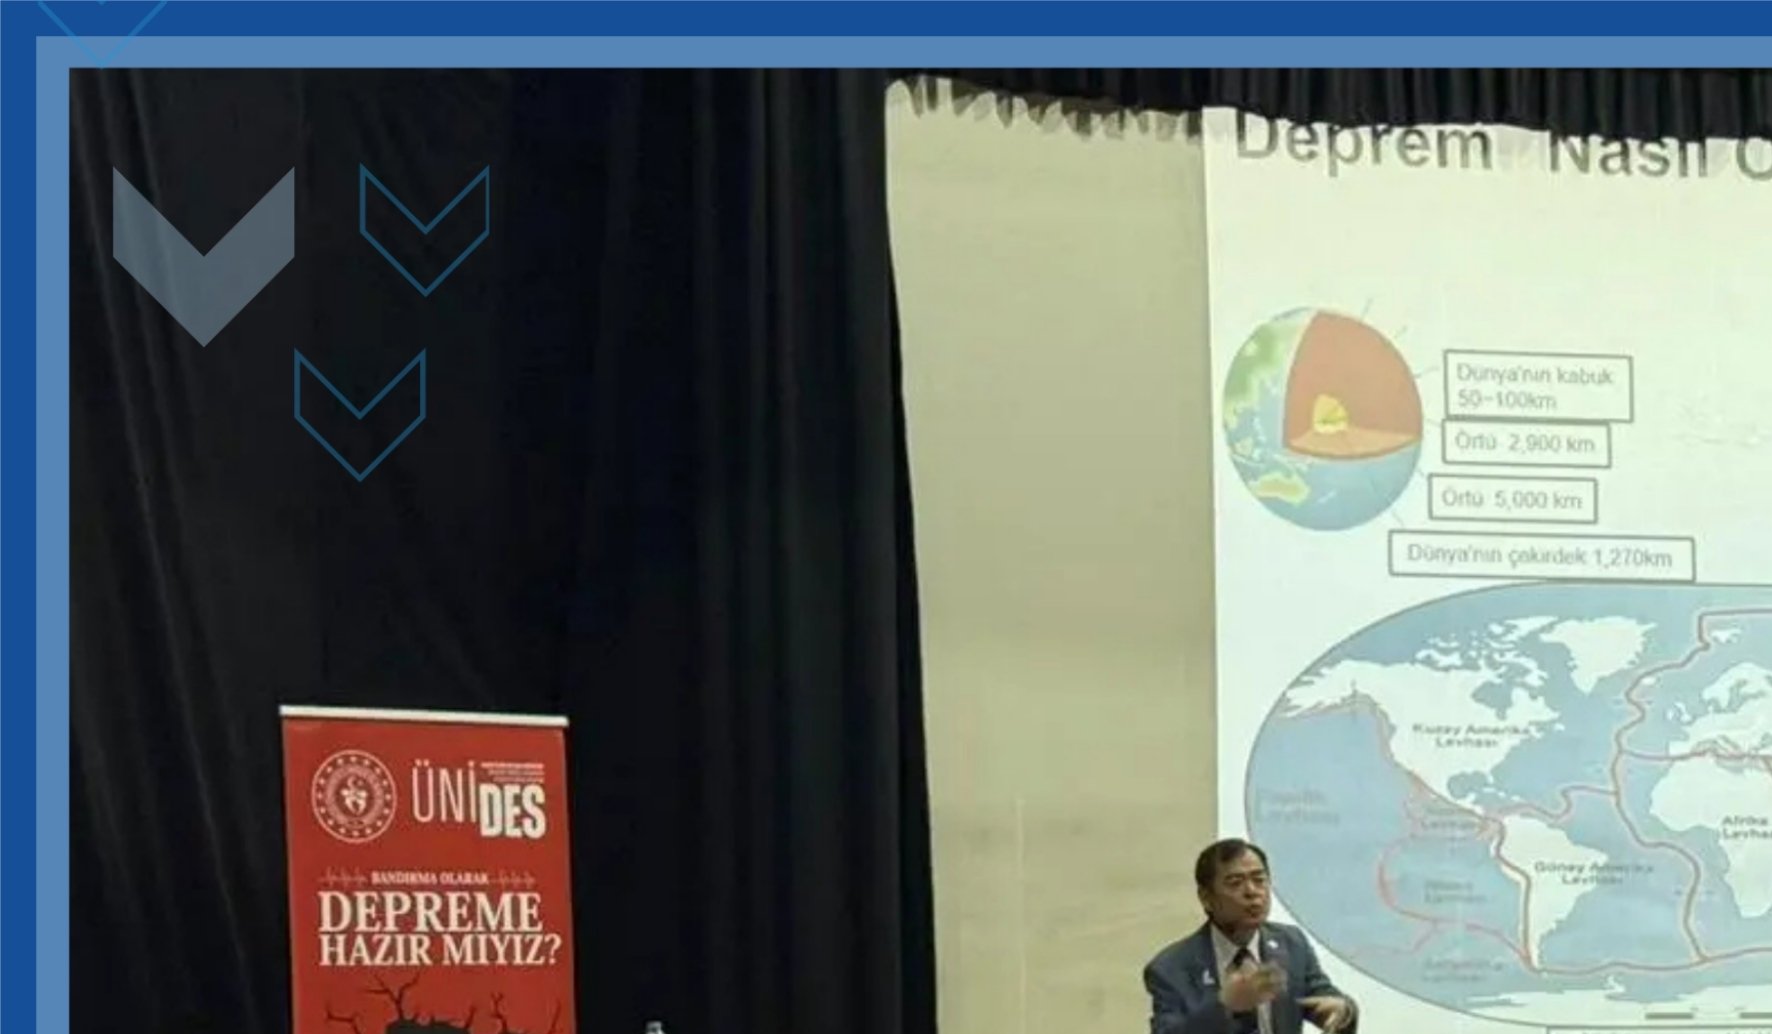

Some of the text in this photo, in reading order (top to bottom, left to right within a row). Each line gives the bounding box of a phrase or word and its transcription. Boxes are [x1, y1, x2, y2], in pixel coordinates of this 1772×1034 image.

[1235, 109, 1492, 178] Deprem
[1550, 137, 1708, 179] Nasıl
[1456, 363, 1615, 386] Dünya'nın kabuk
[1508, 433, 1562, 456] 2,900
[1566, 434, 1596, 453] km
[1494, 490, 1548, 512] 5,000
[1552, 490, 1583, 510] km
[1407, 543, 1503, 566] Dünya'nın
[1593, 548, 1673, 570] 1,270km
[317, 890, 544, 933] DEPREME
[319, 932, 562, 967] HAZIR MIYIZ?
